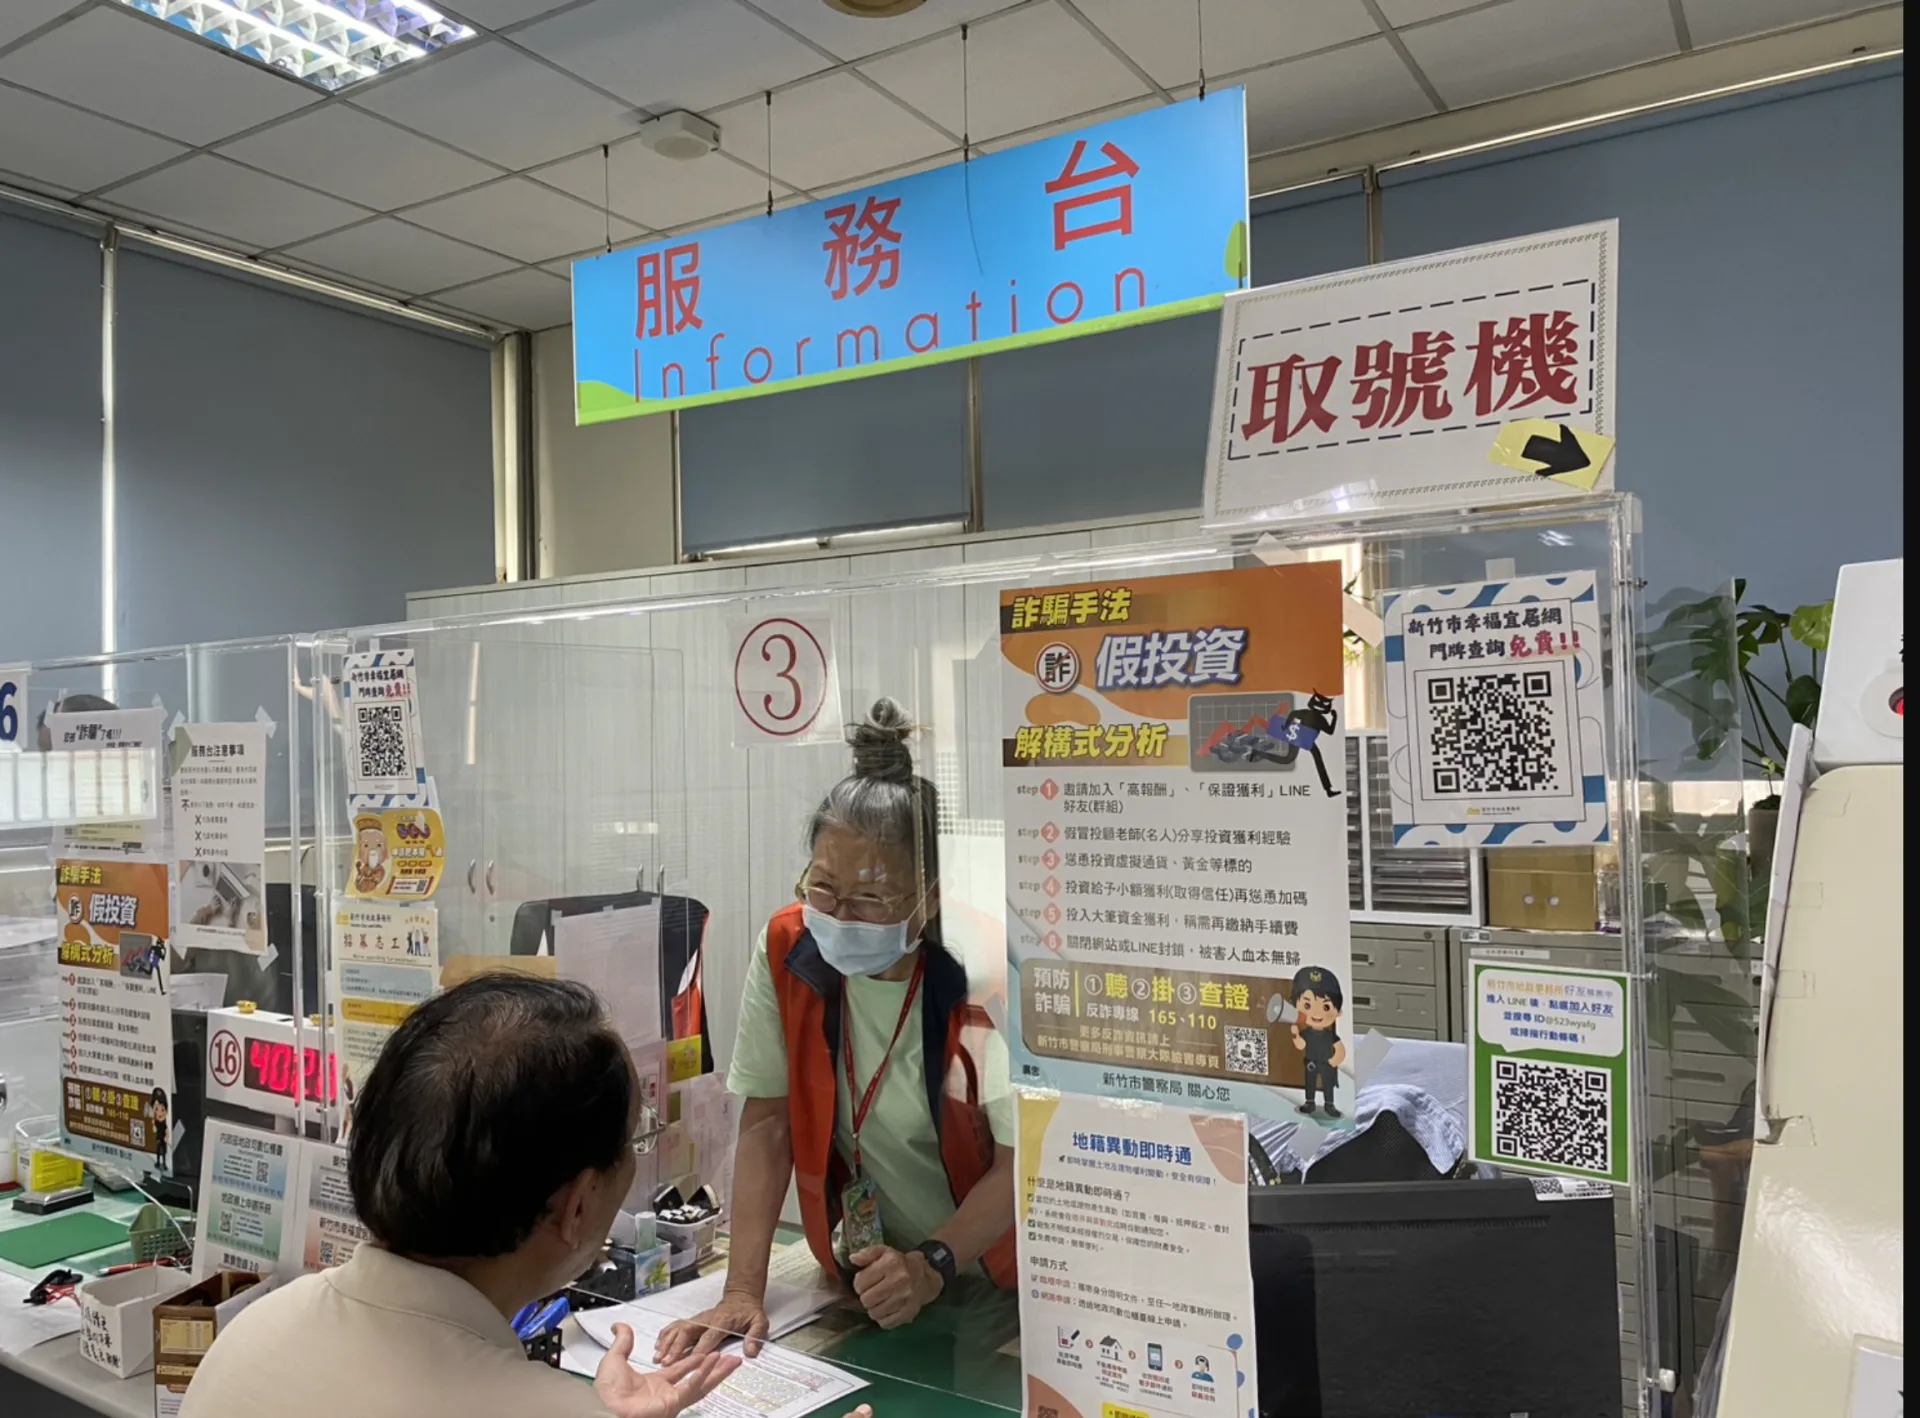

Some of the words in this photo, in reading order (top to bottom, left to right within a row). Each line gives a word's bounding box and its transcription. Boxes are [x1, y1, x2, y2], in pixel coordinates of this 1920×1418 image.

[635, 267, 1146, 403] Information
[1241, 310, 1580, 443] 取號機
[1011, 588, 1132, 629] 詐騙手法
[1407, 607, 1563, 636] 新竹市幸福宜居網
[1096, 627, 1246, 688] 假投資
[761, 633, 802, 721] 3
[1014, 723, 1169, 760] 解構式分析
[1017, 784, 1038, 796] step
[1063, 799, 1124, 814] 好友(群組)
[1017, 827, 1039, 839] step
[1018, 854, 1040, 866] step
[1018, 881, 1041, 892] step
[89, 893, 138, 928] 假投資
[1019, 908, 1041, 919] step
[1020, 934, 1042, 946] step
[1033, 967, 1070, 990] 預防
[1034, 991, 1071, 1016] 詐騙
[1086, 1003, 1139, 1023] 反詐專線
[1508, 997, 1528, 1006] LINE
[214, 1039, 237, 1076] 16
[1103, 1072, 1182, 1096] 新竹市警察局
[1188, 1082, 1231, 1102] 關心您
[1072, 1131, 1192, 1166] 地籍異動即時通
[1030, 1256, 1068, 1271] 申請方式
